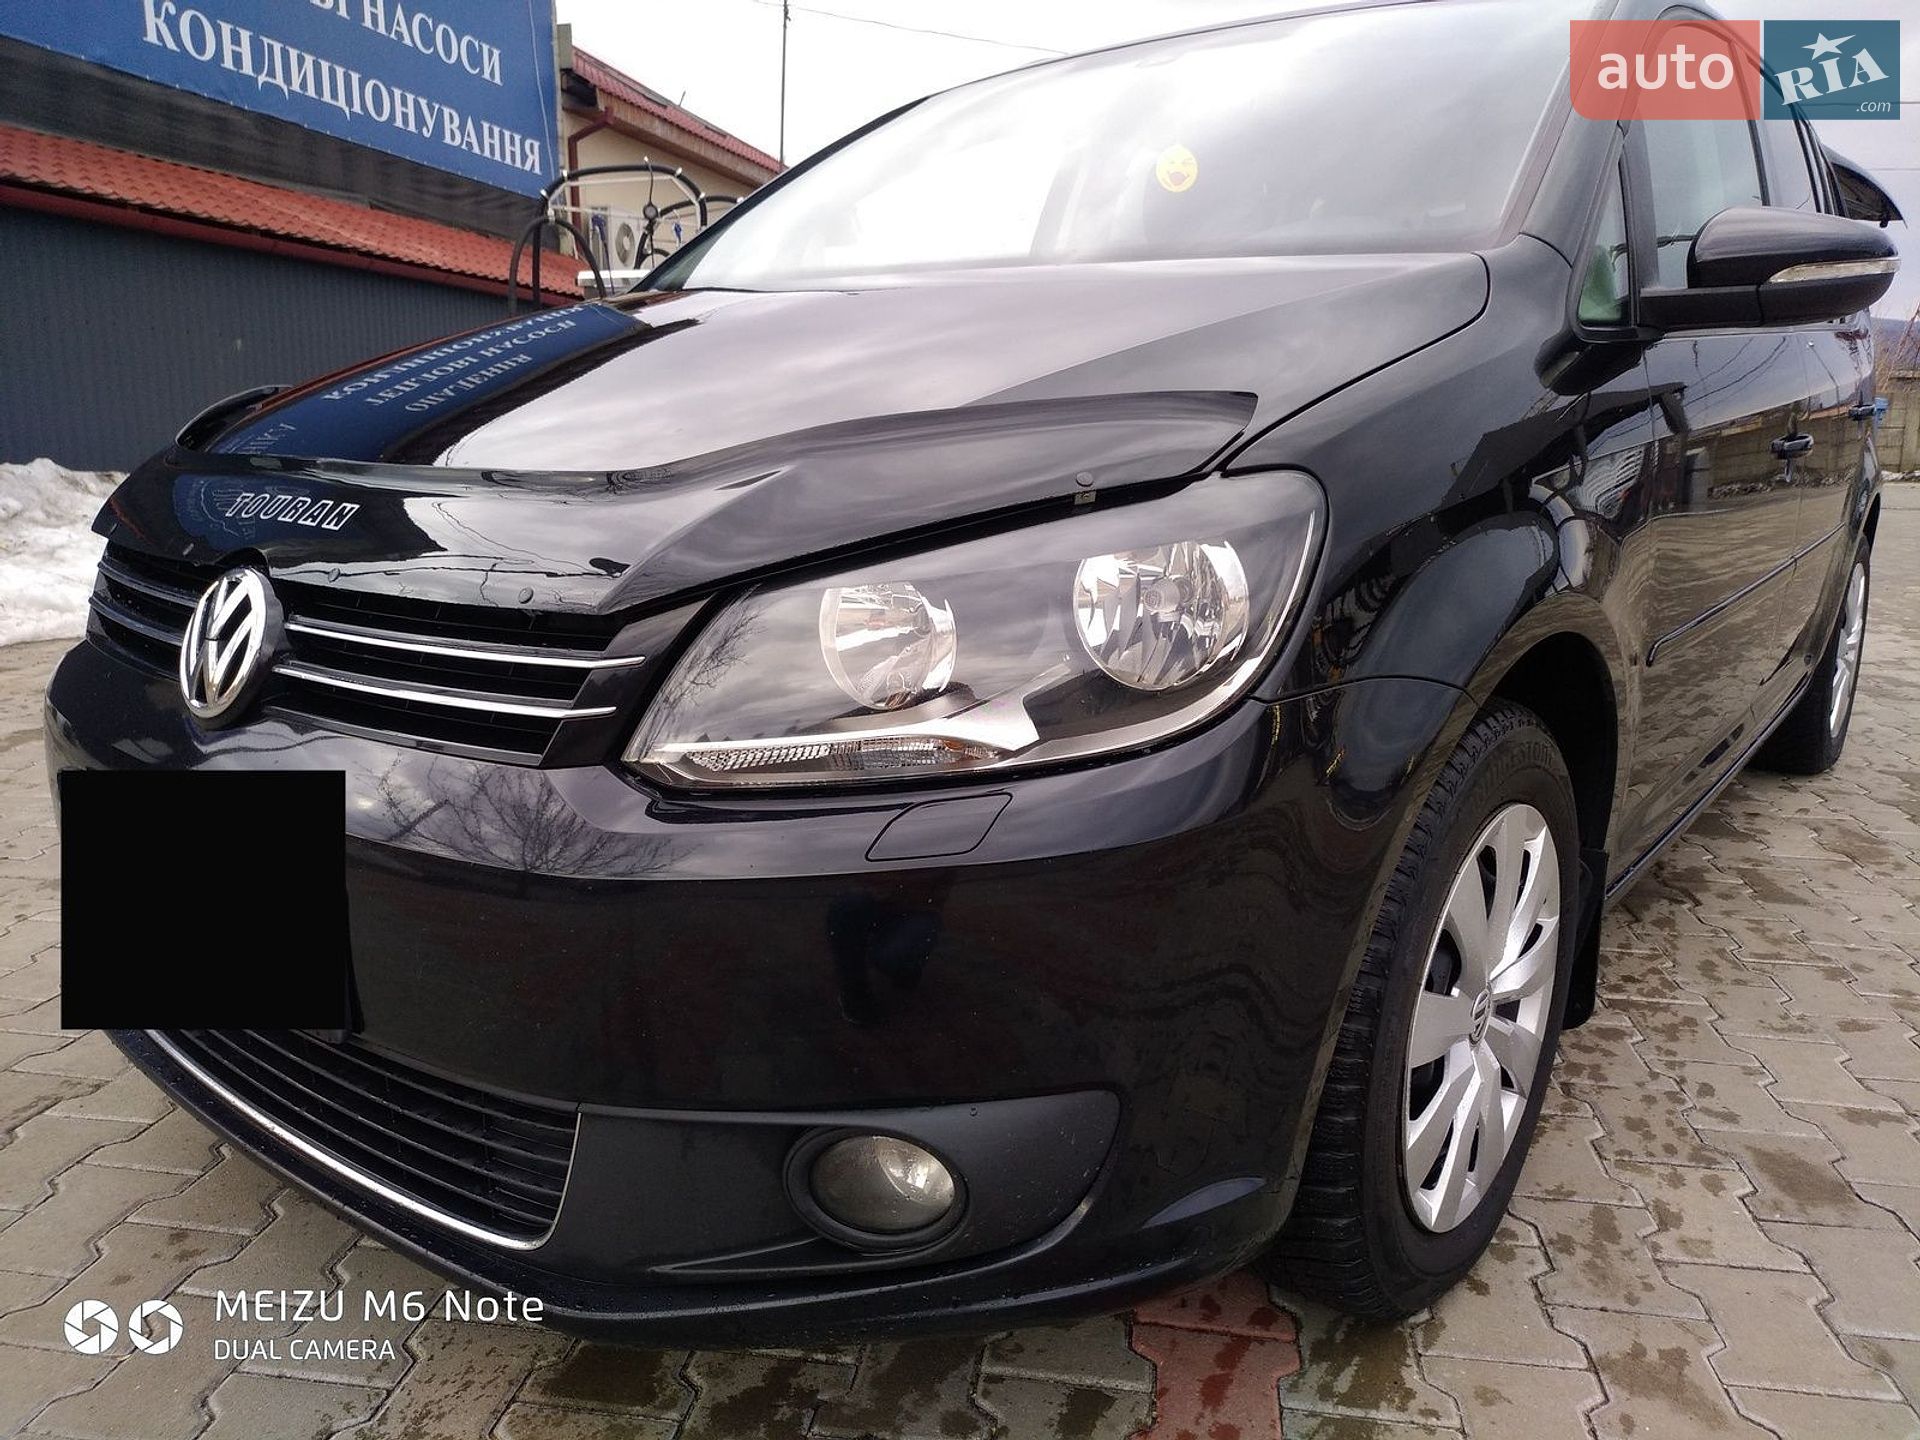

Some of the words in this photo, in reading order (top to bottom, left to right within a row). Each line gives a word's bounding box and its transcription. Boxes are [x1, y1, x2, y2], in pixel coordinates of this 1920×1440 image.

[361, 0, 503, 86] НАСОСИ
[143, 0, 542, 175] КОНДИЦІОНУВАННЯ
[225, 492, 361, 531] TOURAN
